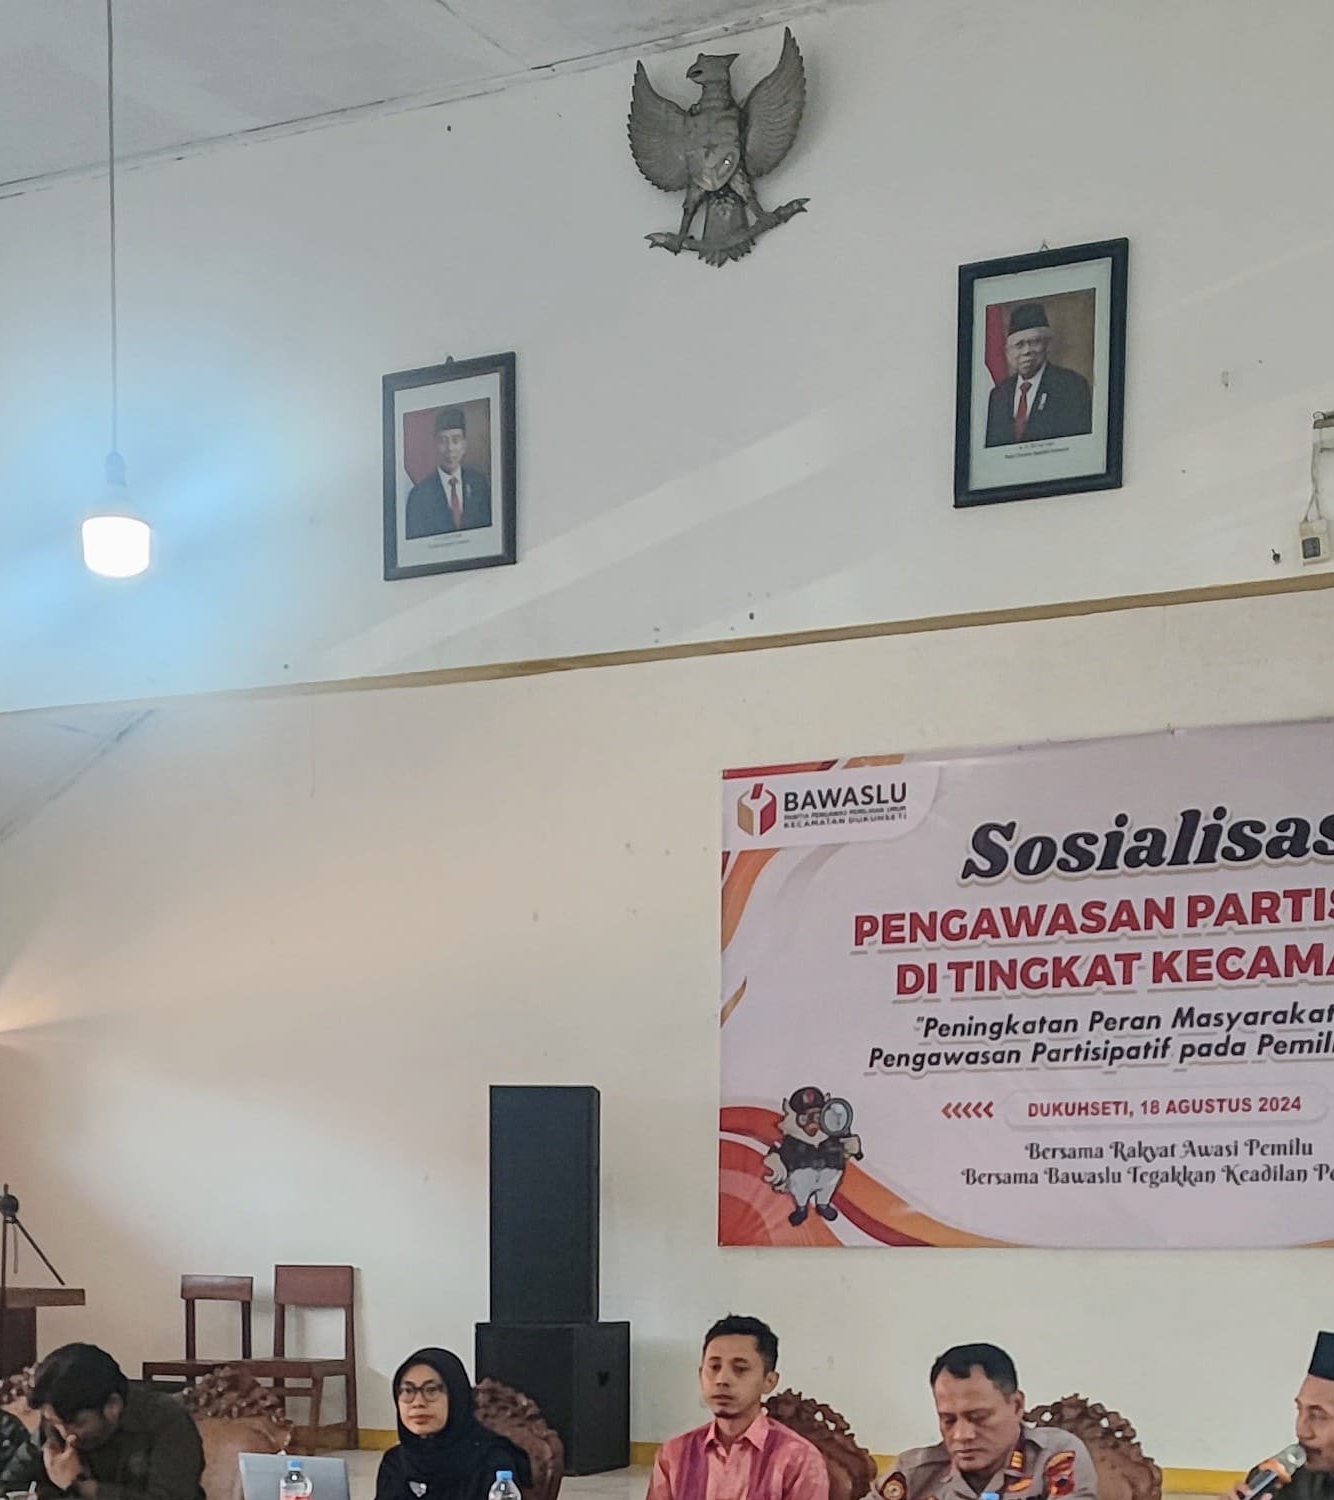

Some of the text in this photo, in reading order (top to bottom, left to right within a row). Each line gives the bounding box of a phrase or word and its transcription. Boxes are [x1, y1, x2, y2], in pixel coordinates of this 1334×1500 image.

[784, 782, 907, 812] BAWASLU
[784, 818, 845, 829] KECAMATAN
[854, 897, 1175, 946] PENGAWASAN
[896, 963, 937, 996] DI
[948, 952, 1142, 993] TINGKAT
[916, 1013, 1079, 1041] "Peningkatan
[1088, 1010, 1162, 1033] Peran
[869, 1047, 1022, 1072] Pengawasan
[1031, 1036, 1173, 1066] Partisipatif
[1179, 1034, 1247, 1063] pada
[1028, 1096, 1302, 1118] DUKUHSETI, 18 AGUSTUS 2024
[1025, 1137, 1314, 1163] Bersama Rakyat Awasi Pemilu
[961, 1168, 1039, 1185] Bersama
[1043, 1166, 1122, 1185] Bawaslu
[1127, 1165, 1216, 1189] Tegakkan
[1221, 1163, 1308, 1186] Keadilan
